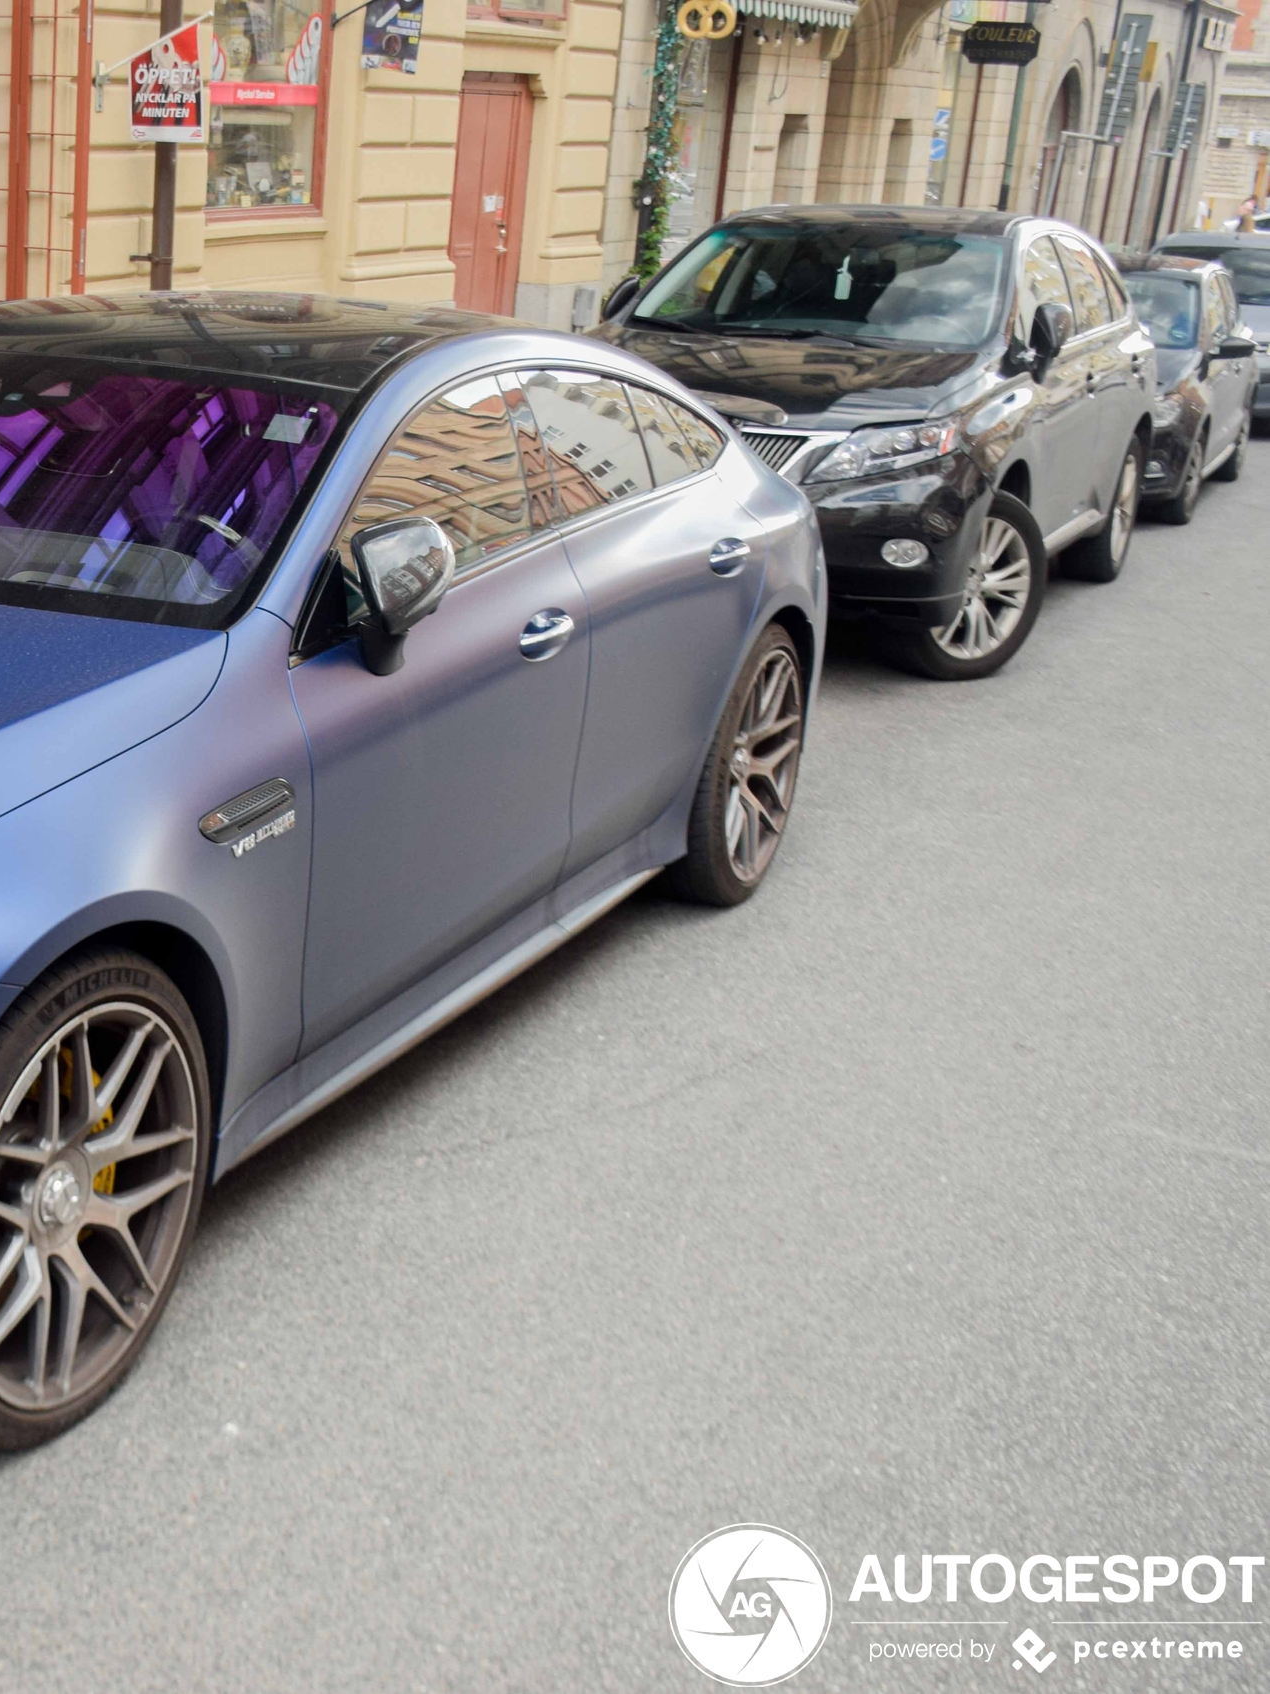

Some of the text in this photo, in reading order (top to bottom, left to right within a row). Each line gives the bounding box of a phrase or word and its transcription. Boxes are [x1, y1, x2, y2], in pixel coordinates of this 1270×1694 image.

[967, 26, 1037, 44] COULEUR
[135, 63, 197, 84] ÖPPET!
[135, 92, 182, 104] NYCKLAR
[141, 107, 190, 118] MINUTEN
[63, 968, 150, 1003] MICHELIN
